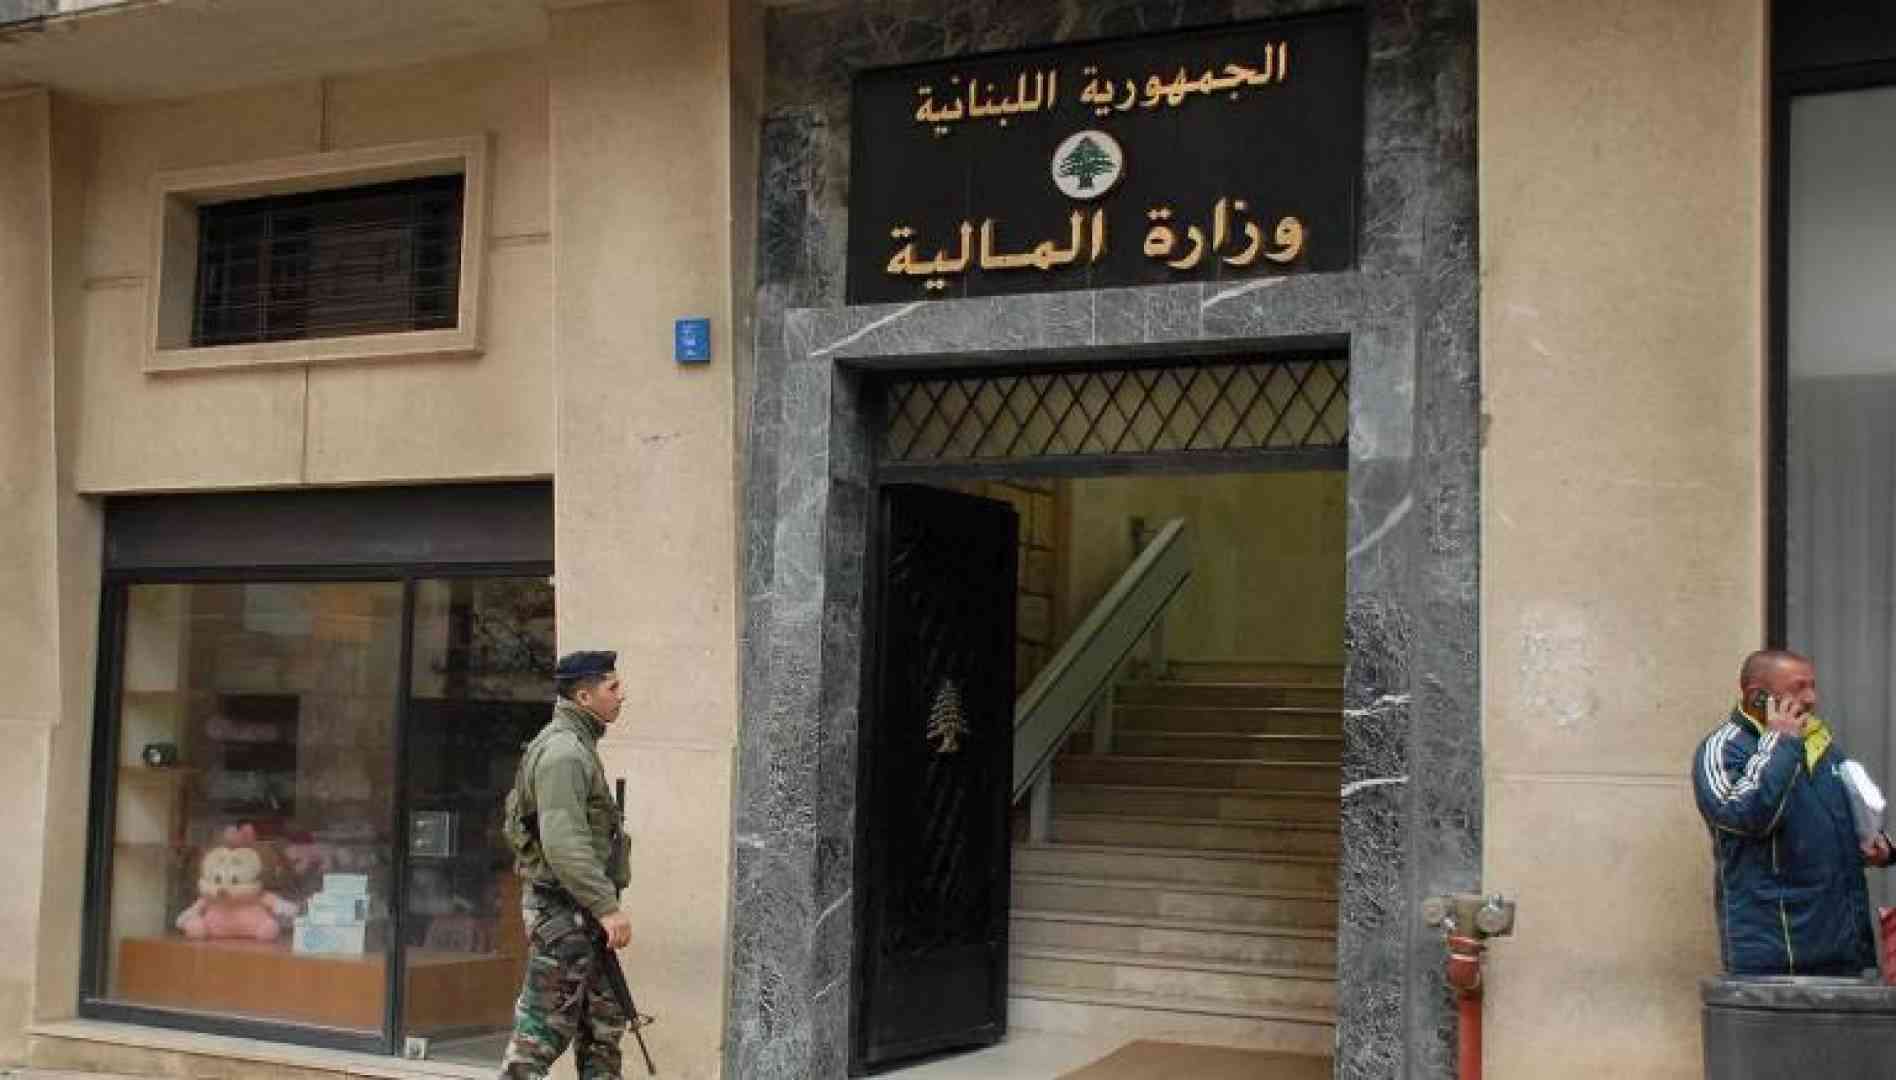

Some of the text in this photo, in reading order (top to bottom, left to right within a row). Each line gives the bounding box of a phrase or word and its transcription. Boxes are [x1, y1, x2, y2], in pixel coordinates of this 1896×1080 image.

[915, 41, 1288, 135] الجمهورية اللبنانية
[886, 197, 1306, 290] وزارة المالية
